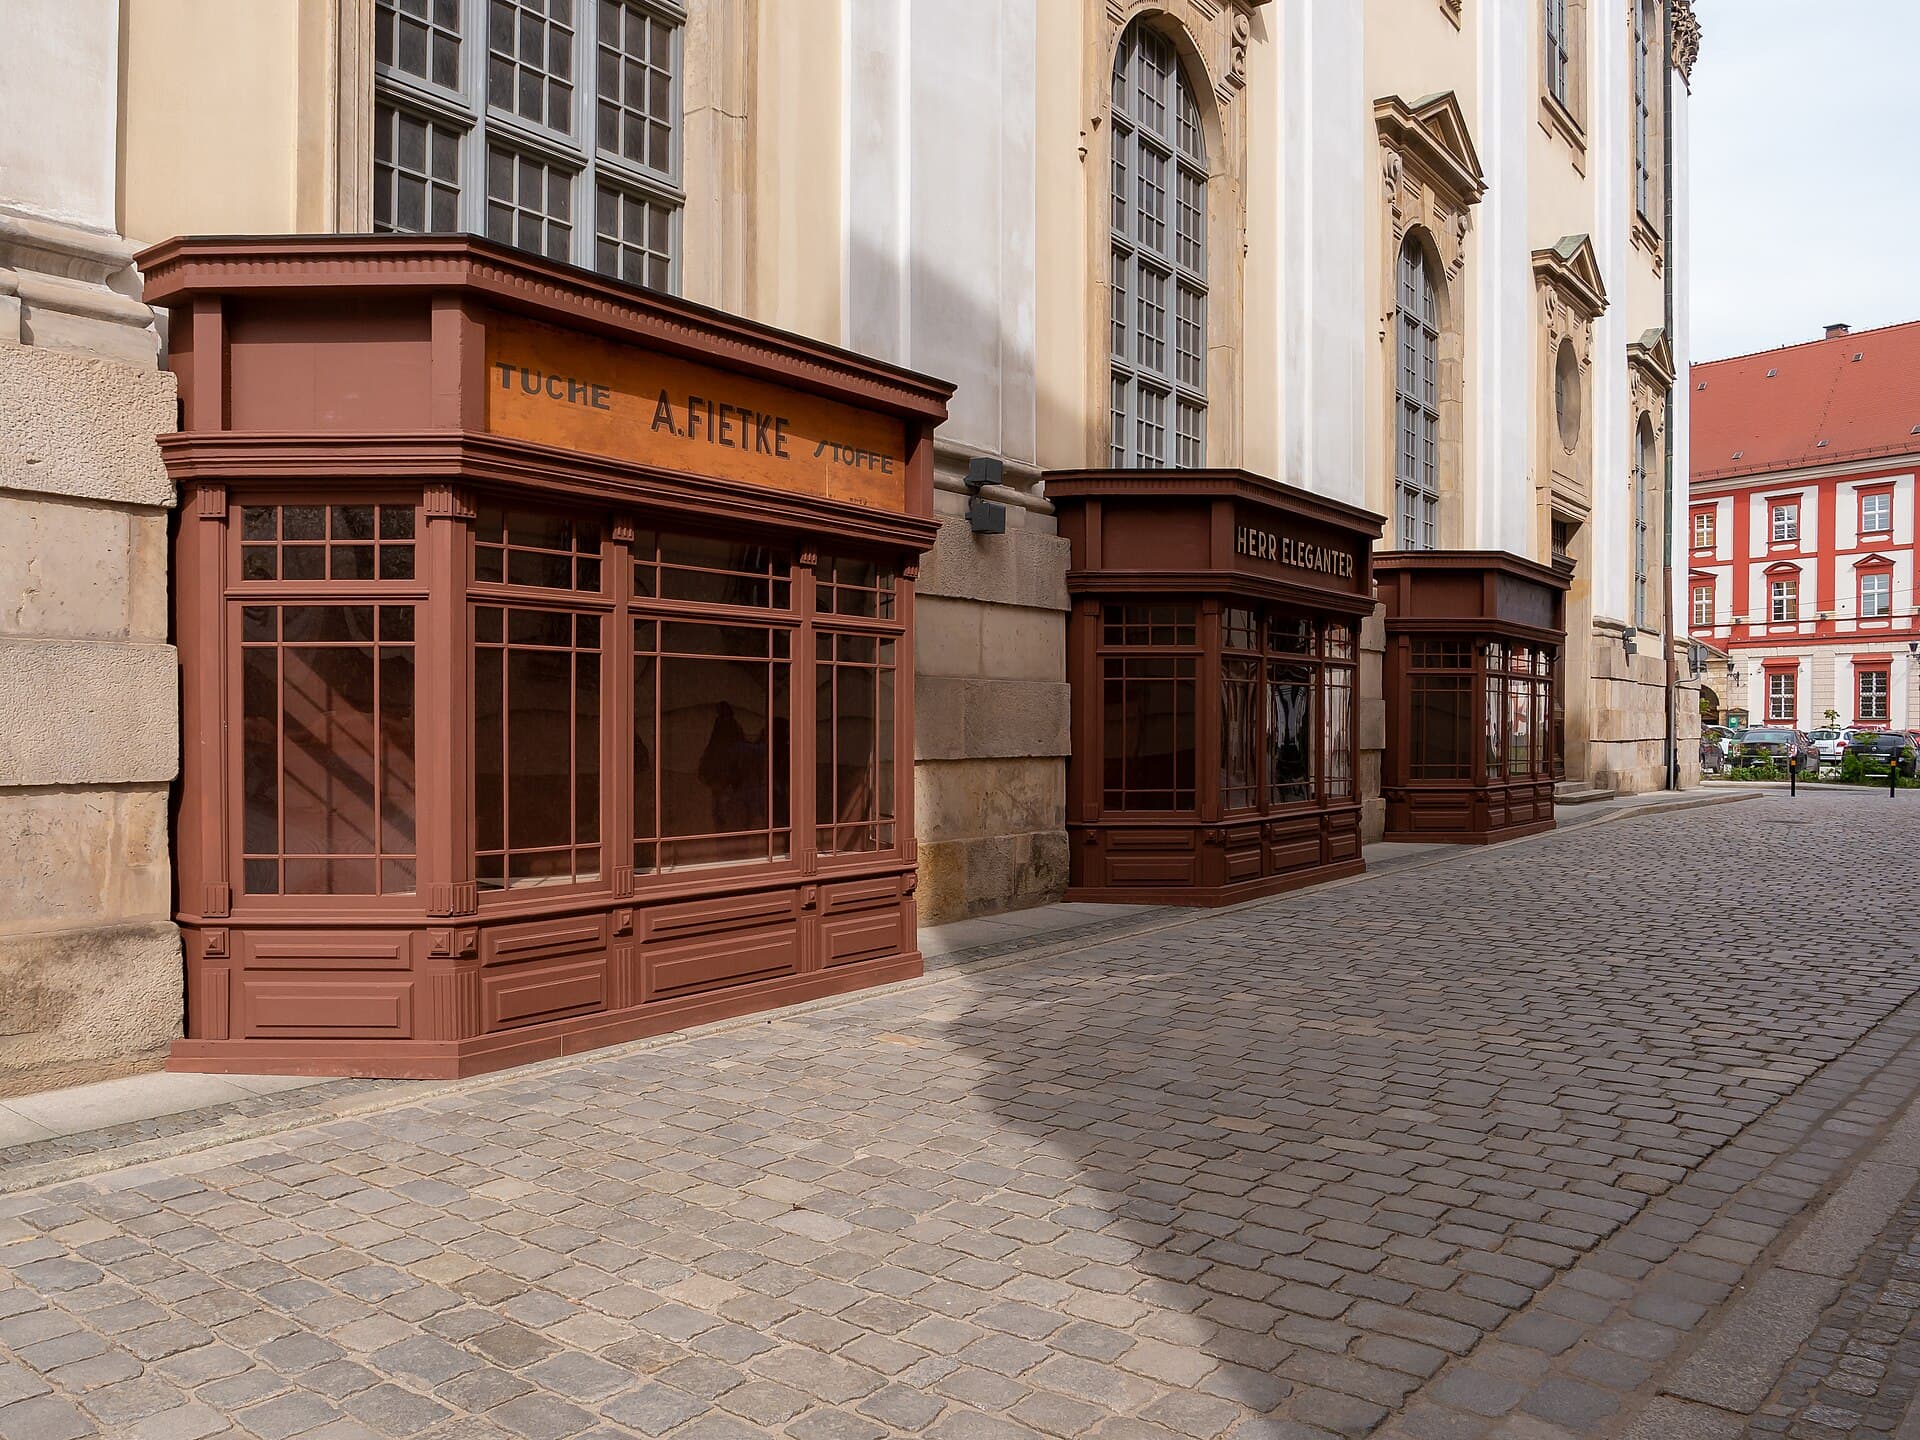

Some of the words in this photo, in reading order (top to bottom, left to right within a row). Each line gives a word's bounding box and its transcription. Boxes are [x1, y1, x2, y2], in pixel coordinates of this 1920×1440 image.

[495, 361, 612, 411] TUCHE
[813, 440, 894, 475] STOFFE
[1237, 525, 1277, 562] HERR
[1281, 537, 1354, 579] ELEGANTER
